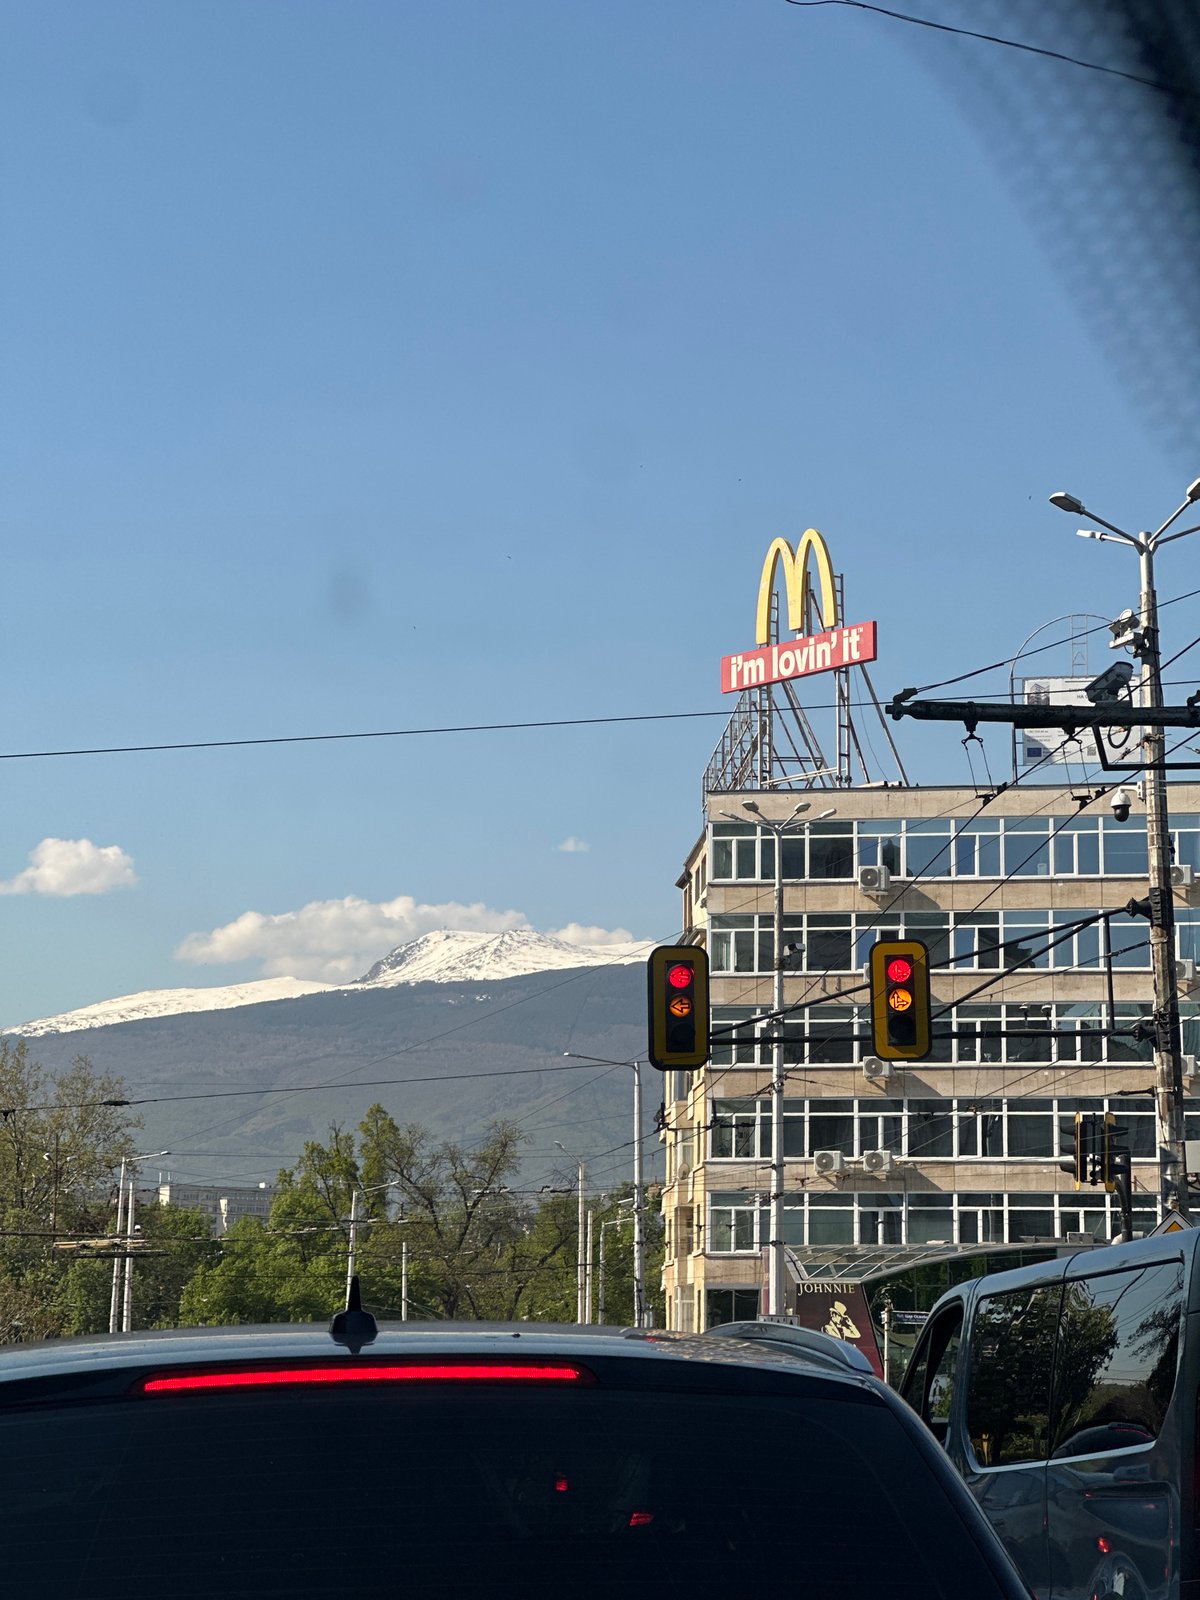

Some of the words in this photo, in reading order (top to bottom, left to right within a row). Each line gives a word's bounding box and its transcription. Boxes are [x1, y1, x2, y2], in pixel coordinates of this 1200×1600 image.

[730, 655, 765, 689] i'm
[772, 632, 838, 679] lovin'
[798, 1283, 856, 1296] JOHNNIE
